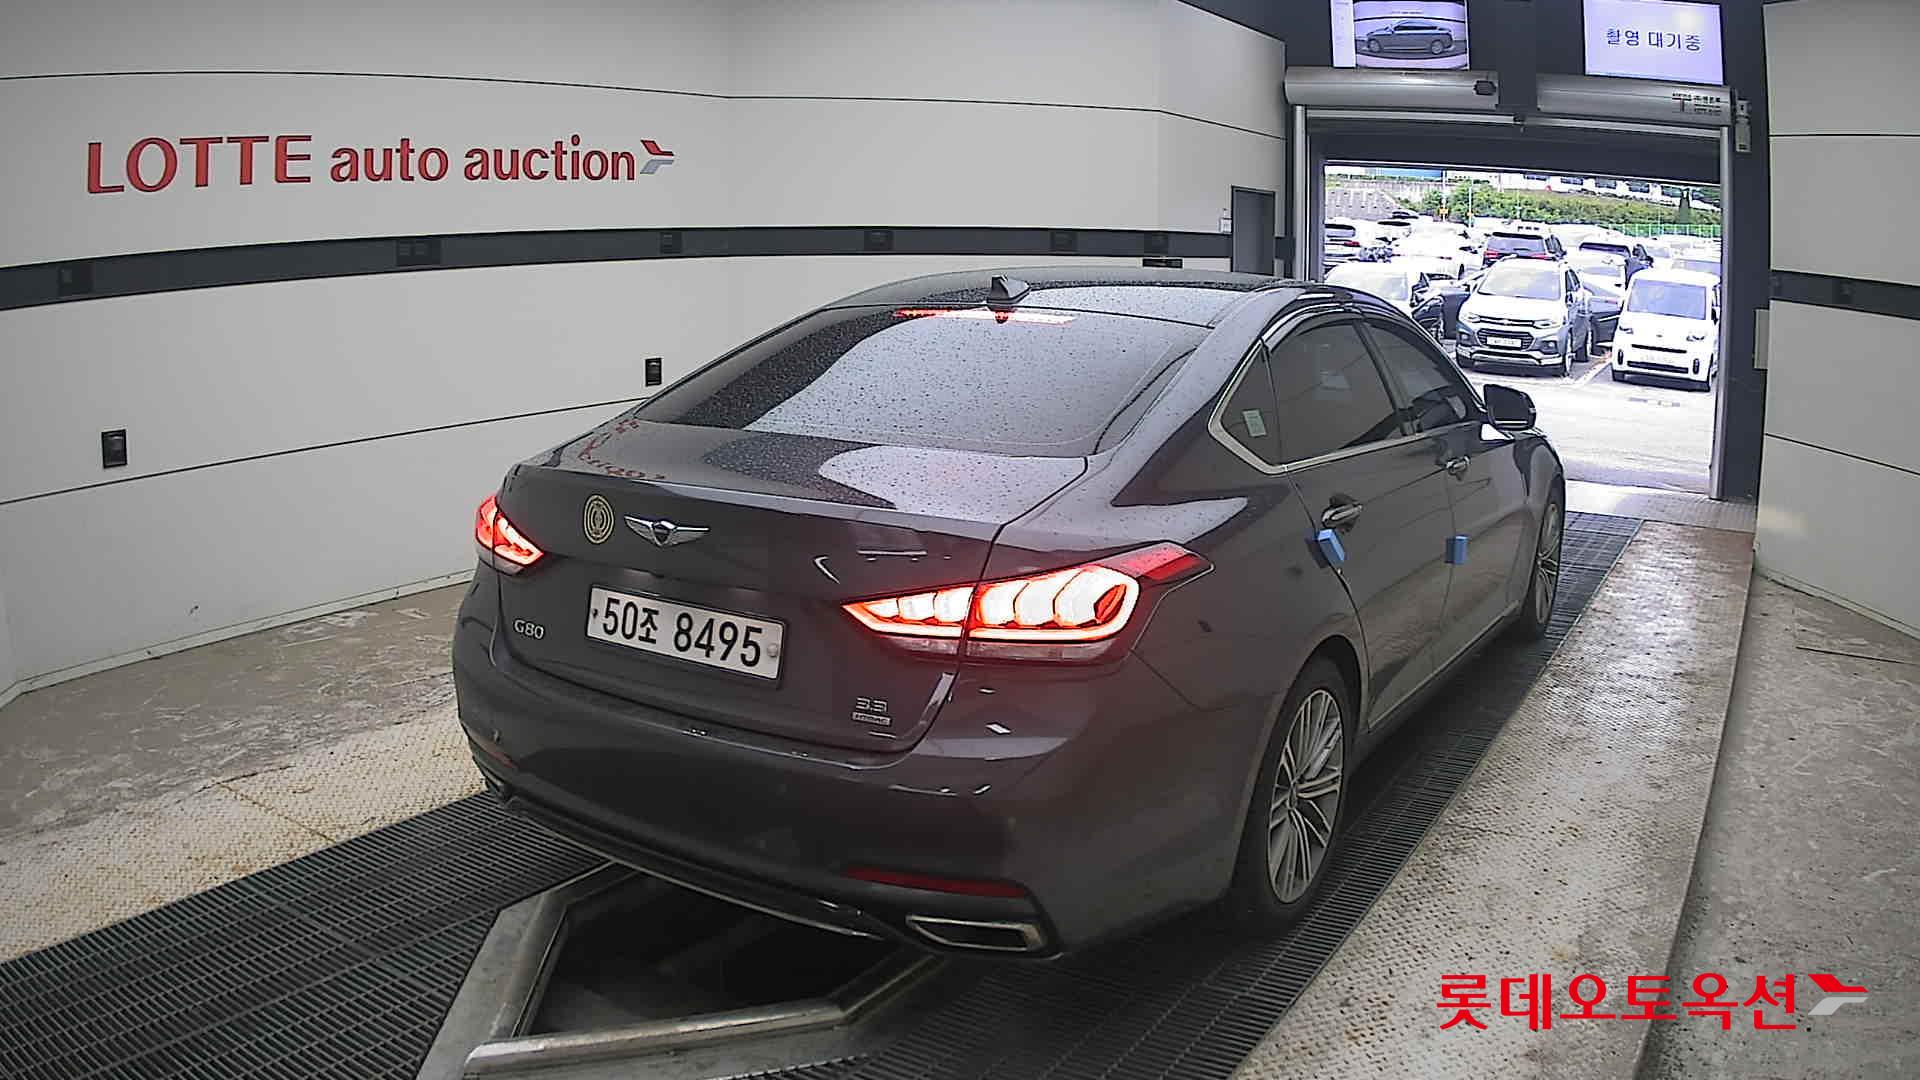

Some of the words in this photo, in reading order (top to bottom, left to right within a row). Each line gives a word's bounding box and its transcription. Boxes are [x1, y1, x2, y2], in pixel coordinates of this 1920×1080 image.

[1606, 28, 1640, 47] 촬영
[1648, 32, 1701, 51] 대기중
[87, 135, 312, 193] LOTTE
[330, 138, 449, 182] auto
[464, 134, 636, 181] auction
[513, 619, 545, 640] G80
[602, 598, 659, 644] 50조
[673, 612, 763, 668] 8495
